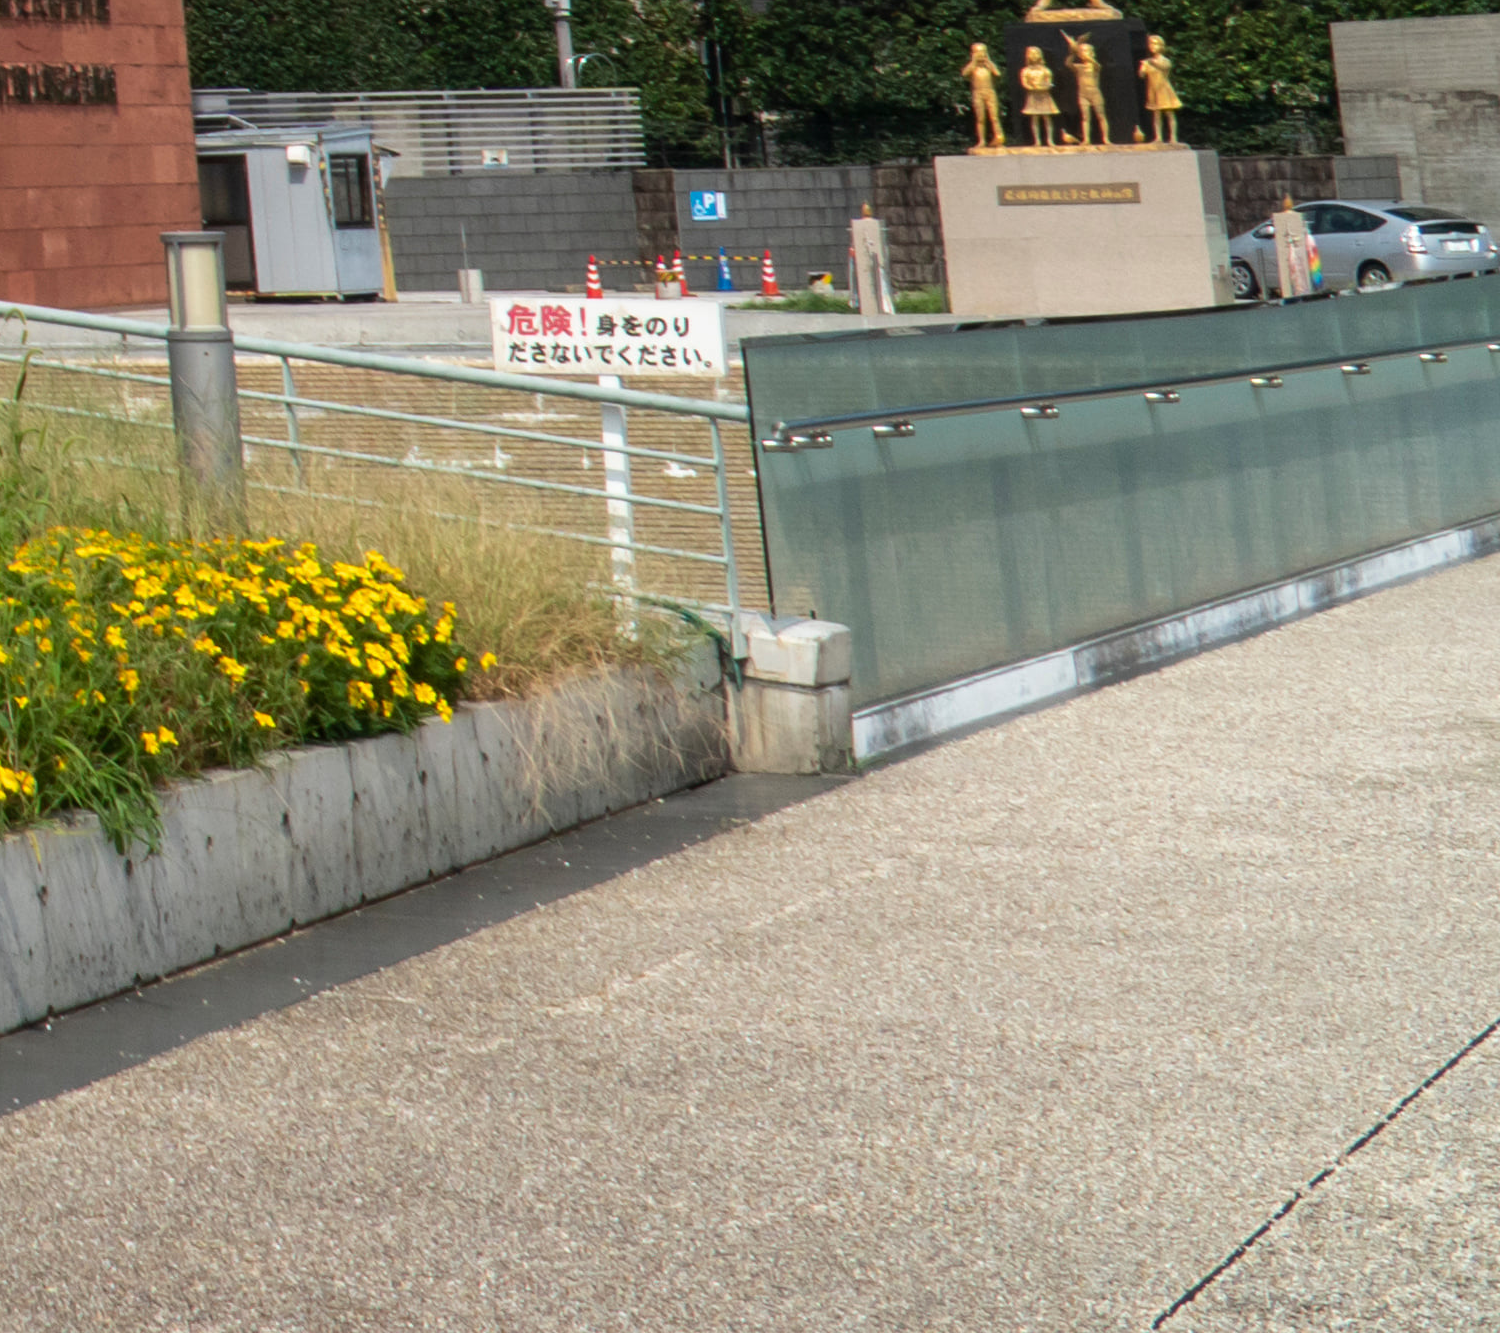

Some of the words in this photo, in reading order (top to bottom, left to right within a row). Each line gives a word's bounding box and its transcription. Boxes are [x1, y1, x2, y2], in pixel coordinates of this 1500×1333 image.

[702, 193, 715, 209] P
[507, 304, 588, 337] 危険！
[596, 313, 690, 337] 身をのり
[509, 341, 713, 369] ださないでください。
